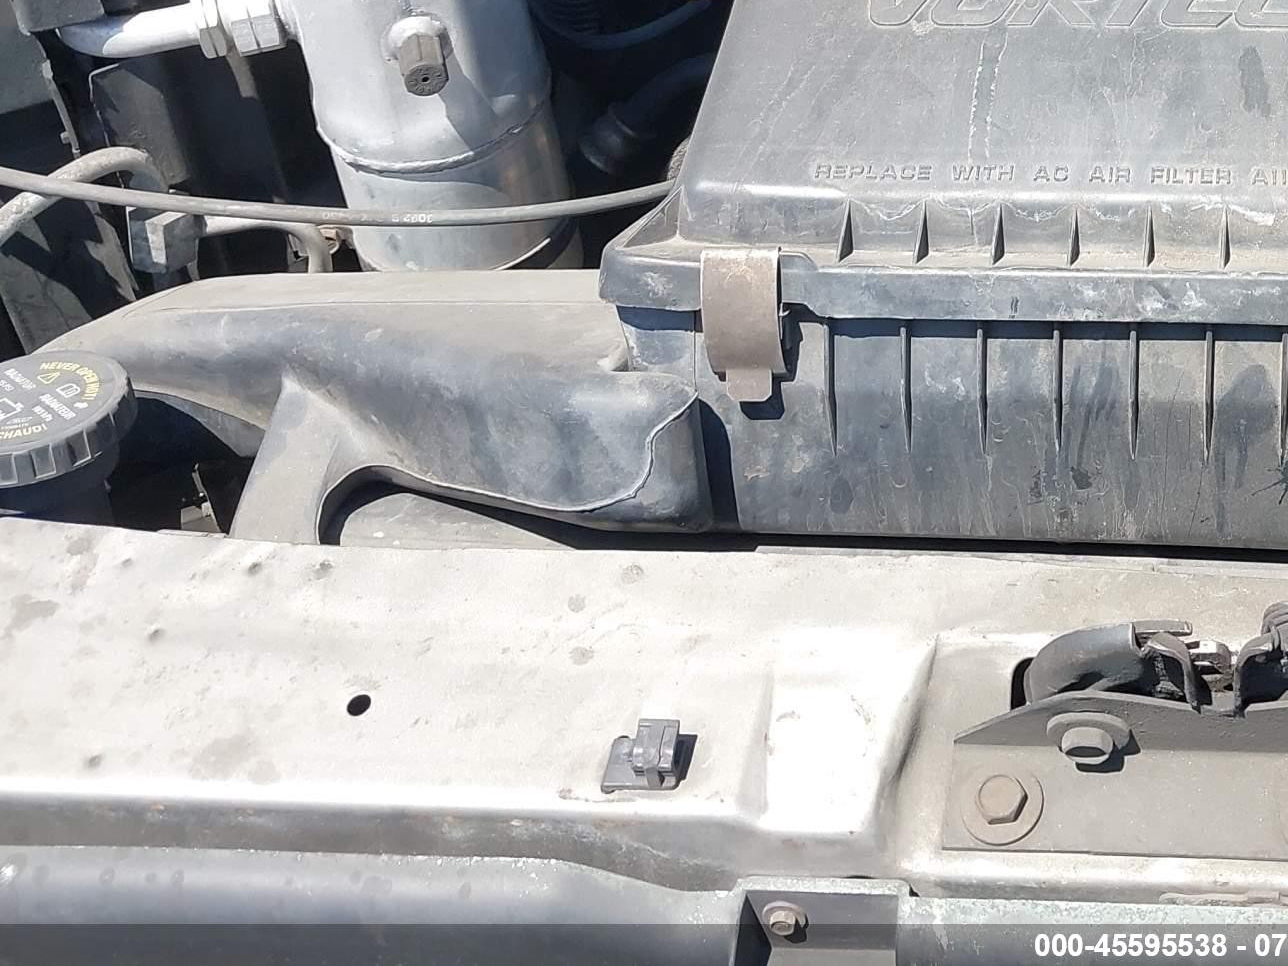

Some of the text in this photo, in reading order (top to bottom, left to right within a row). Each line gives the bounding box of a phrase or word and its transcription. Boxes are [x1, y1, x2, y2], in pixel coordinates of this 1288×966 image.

[813, 163, 933, 181] REPLACE
[951, 164, 1016, 182] WITH
[1032, 165, 1069, 183] AC
[1087, 165, 1132, 184] AIR
[1149, 166, 1233, 185] FILTER
[40, 361, 80, 371] NEVER
